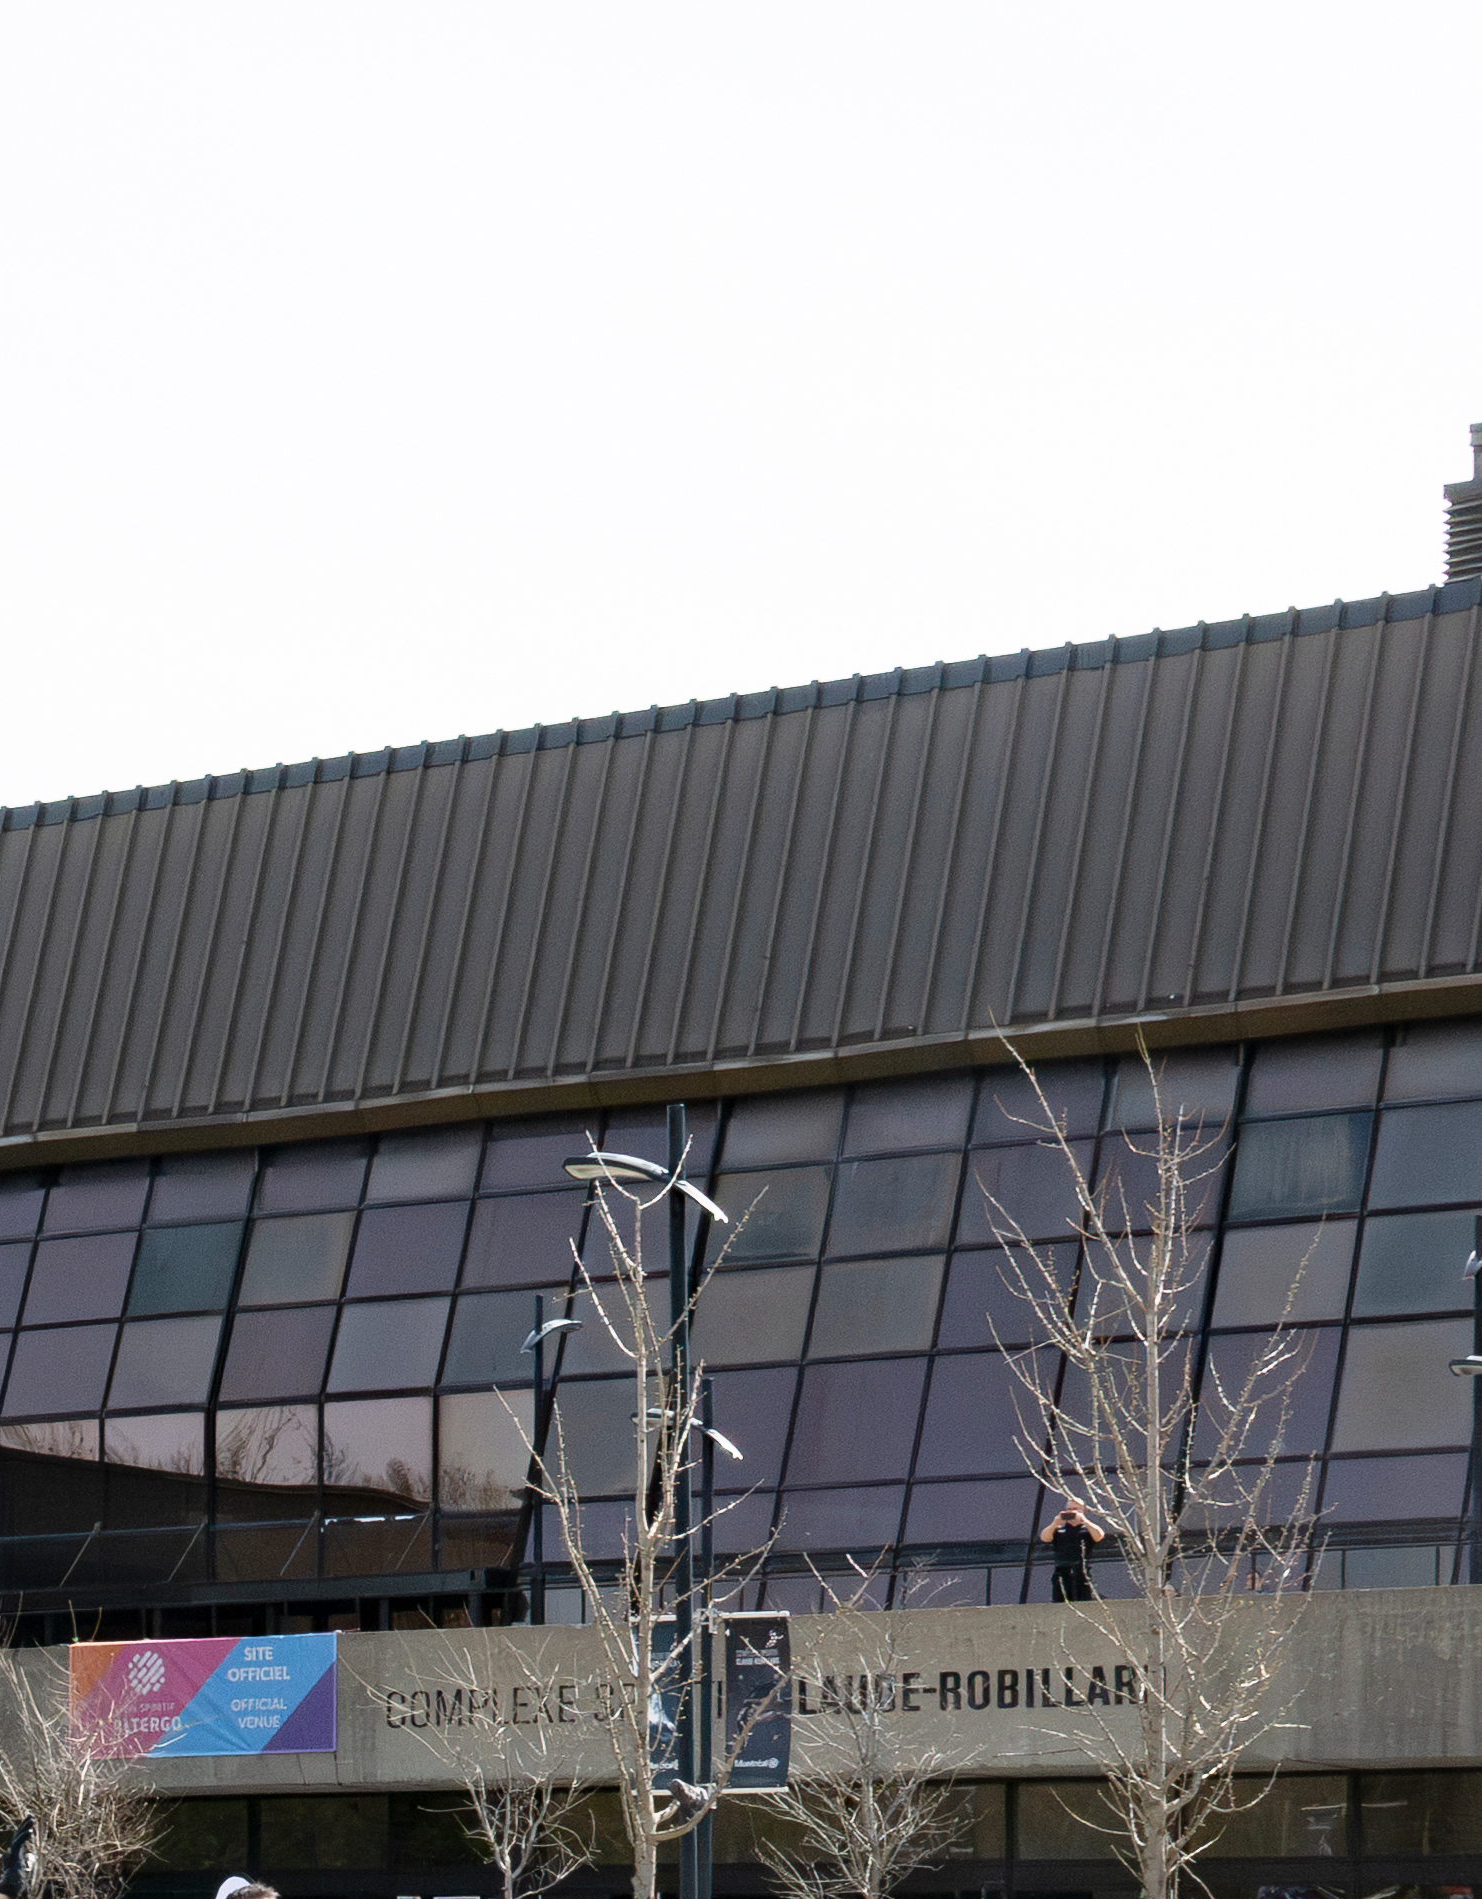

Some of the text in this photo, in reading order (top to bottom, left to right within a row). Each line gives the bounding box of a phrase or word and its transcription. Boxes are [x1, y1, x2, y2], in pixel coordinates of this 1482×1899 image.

[243, 1646, 274, 1662] SITE
[226, 1666, 291, 1682] OFFICIEL
[230, 1697, 288, 1712] OFFICIAL
[238, 1715, 281, 1729] VENUE
